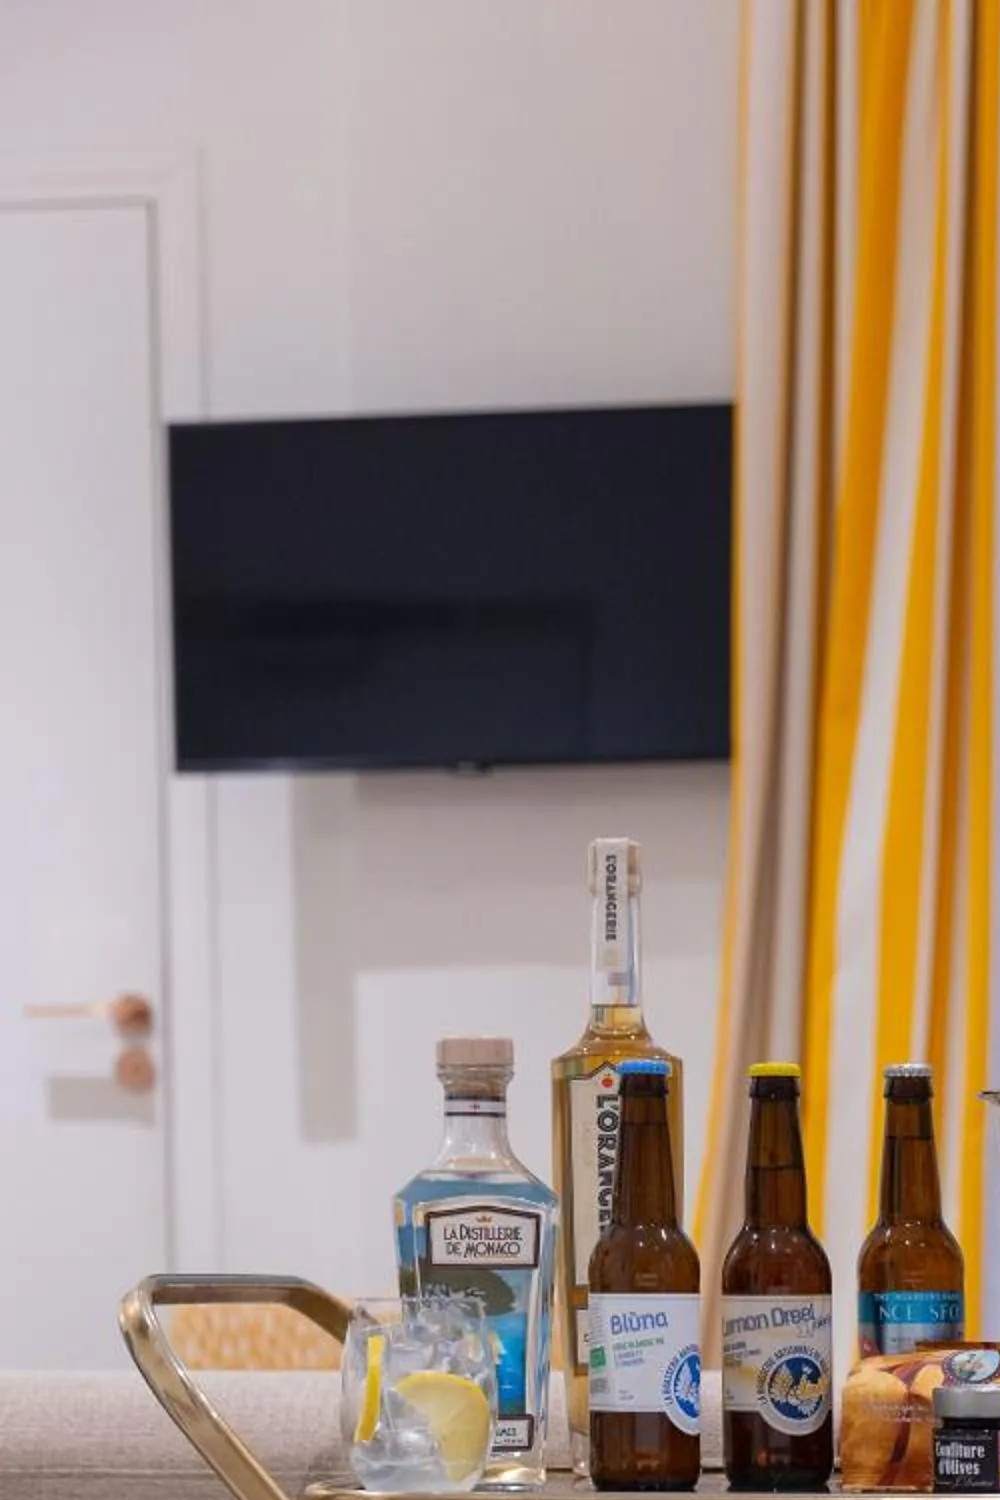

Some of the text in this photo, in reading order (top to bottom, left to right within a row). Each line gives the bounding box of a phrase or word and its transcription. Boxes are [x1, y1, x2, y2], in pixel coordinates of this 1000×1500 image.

[443, 1227, 457, 1241] LA
[445, 1241, 521, 1259] DE MONACO
